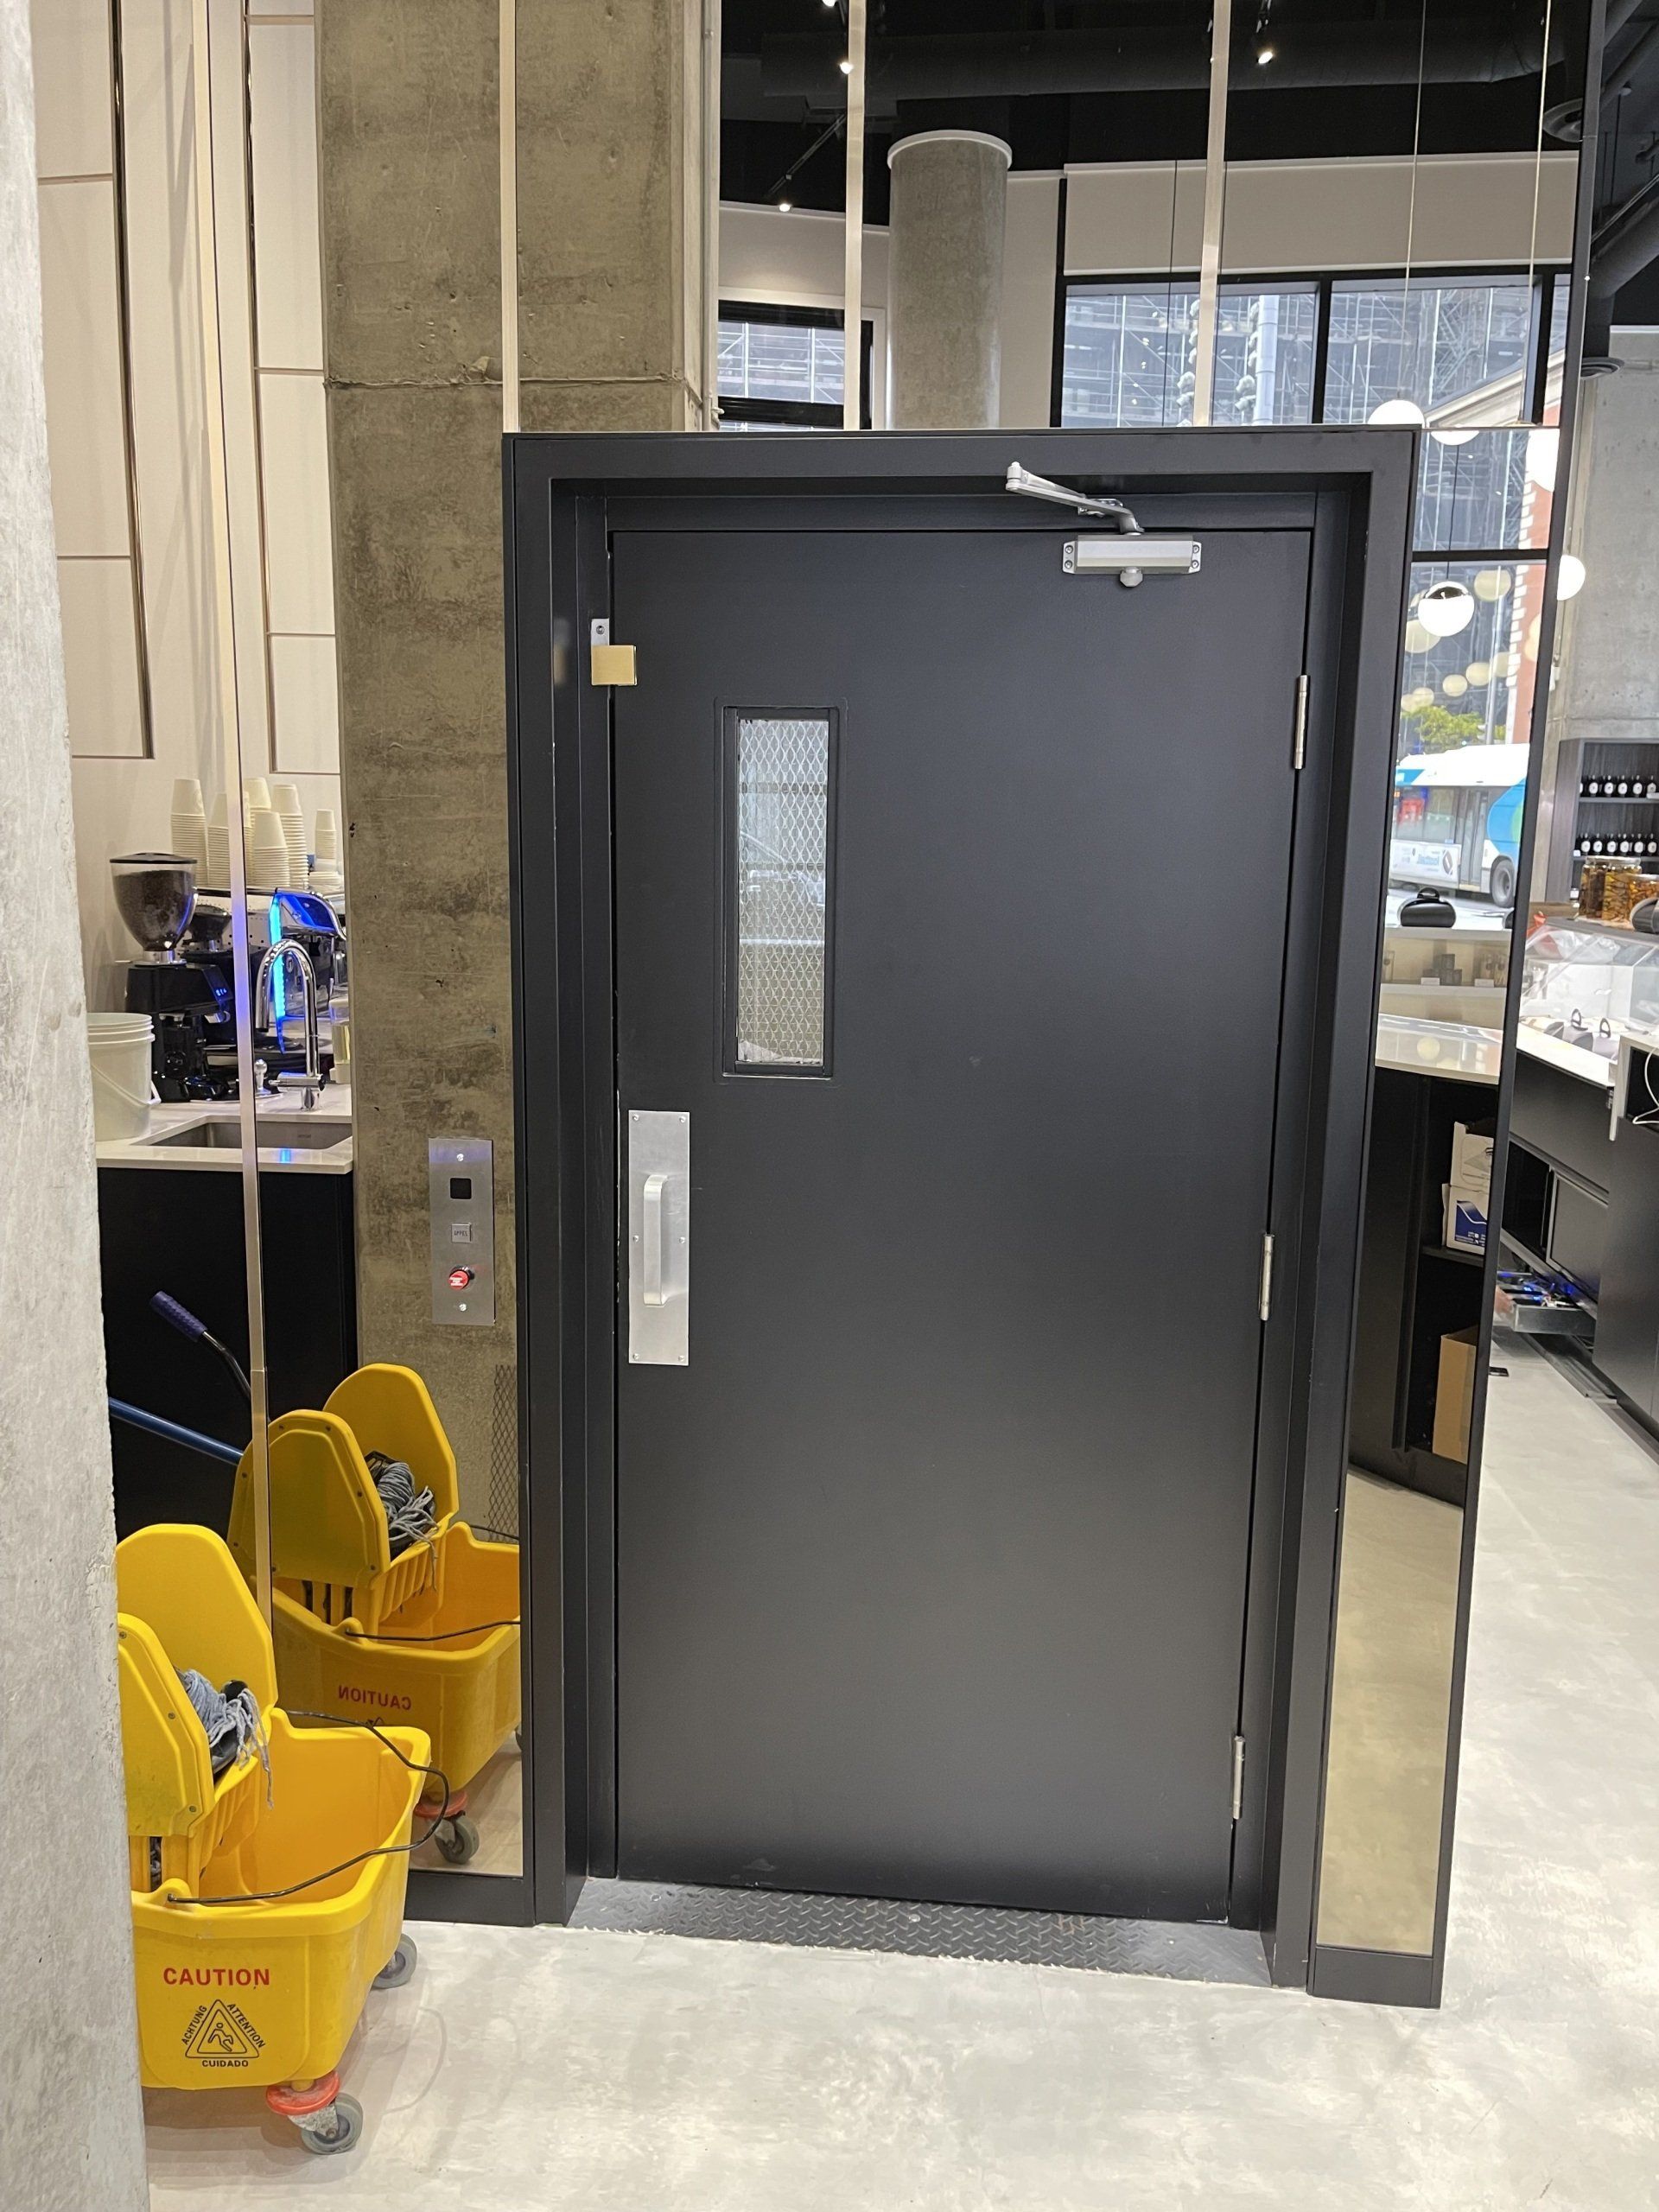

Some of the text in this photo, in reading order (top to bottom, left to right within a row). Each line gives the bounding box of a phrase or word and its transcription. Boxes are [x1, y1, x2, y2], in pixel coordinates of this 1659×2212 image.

[163, 1967, 270, 1986] CAUTION
[181, 2005, 207, 2045] ACHTUNG
[227, 2004, 265, 2048] ATTENTION
